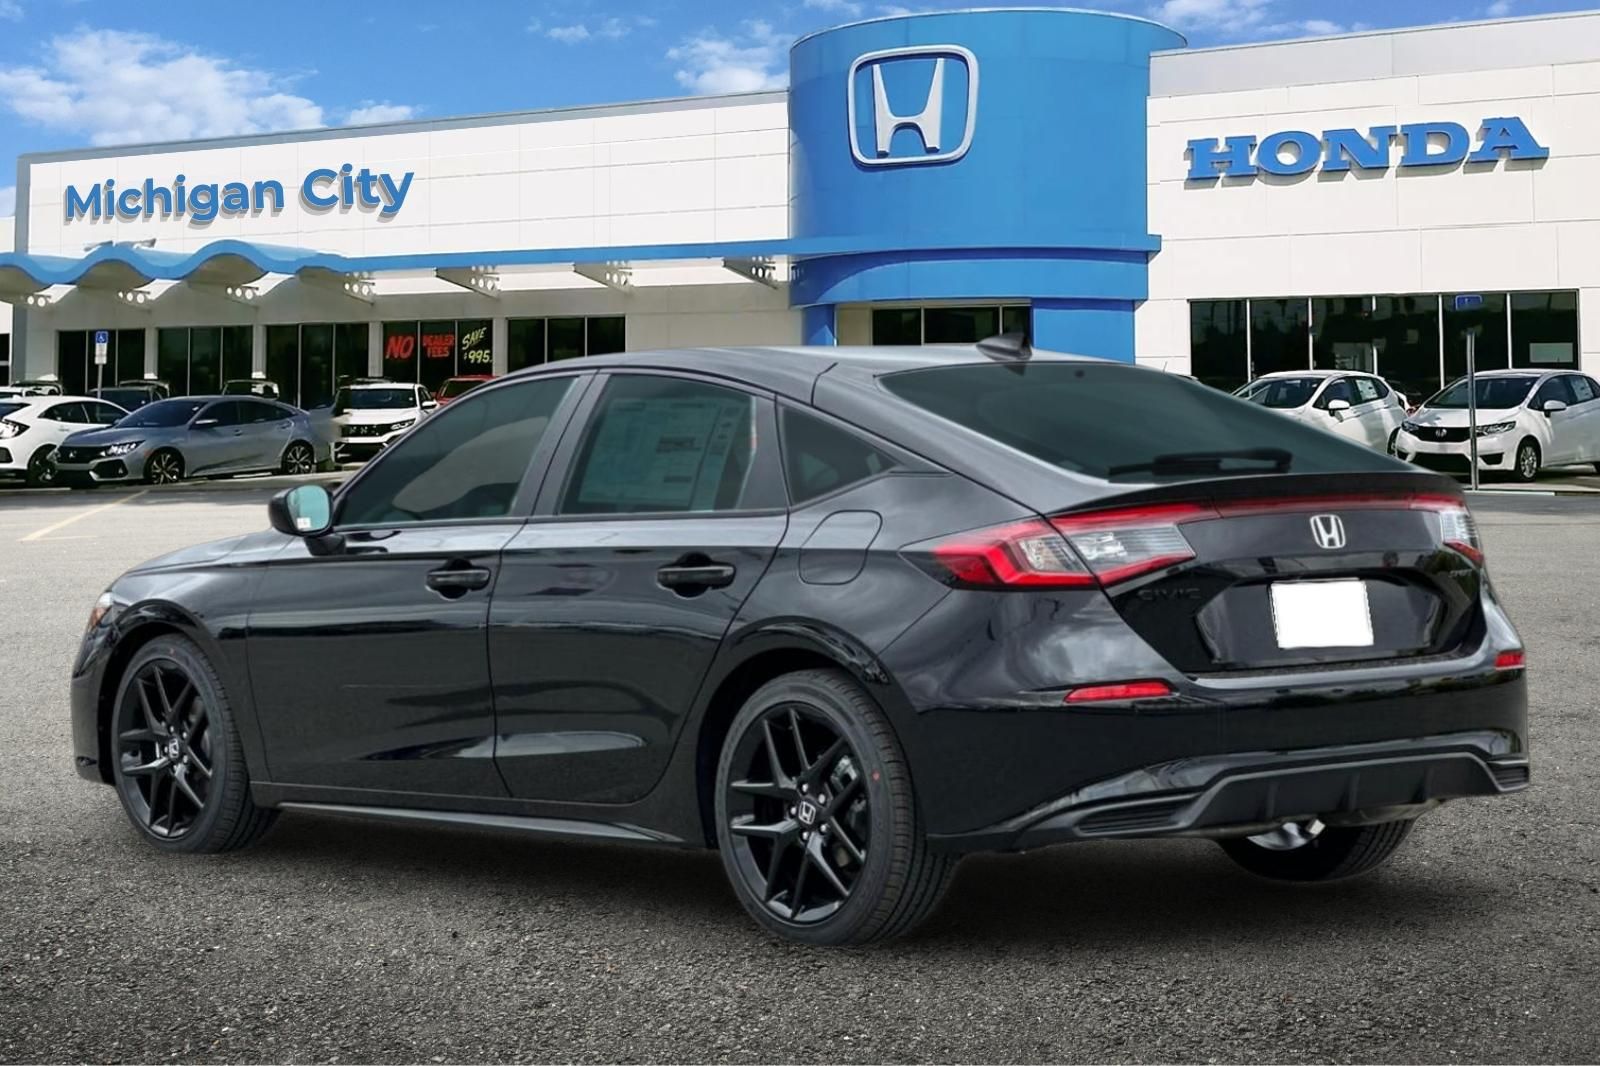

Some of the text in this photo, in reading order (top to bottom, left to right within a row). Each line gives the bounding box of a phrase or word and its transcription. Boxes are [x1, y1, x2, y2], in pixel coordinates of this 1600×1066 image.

[1185, 116, 1550, 183] HONDA
[65, 163, 414, 224] Michigan City
[385, 335, 415, 359] NO
[462, 327, 487, 350] SAVE
